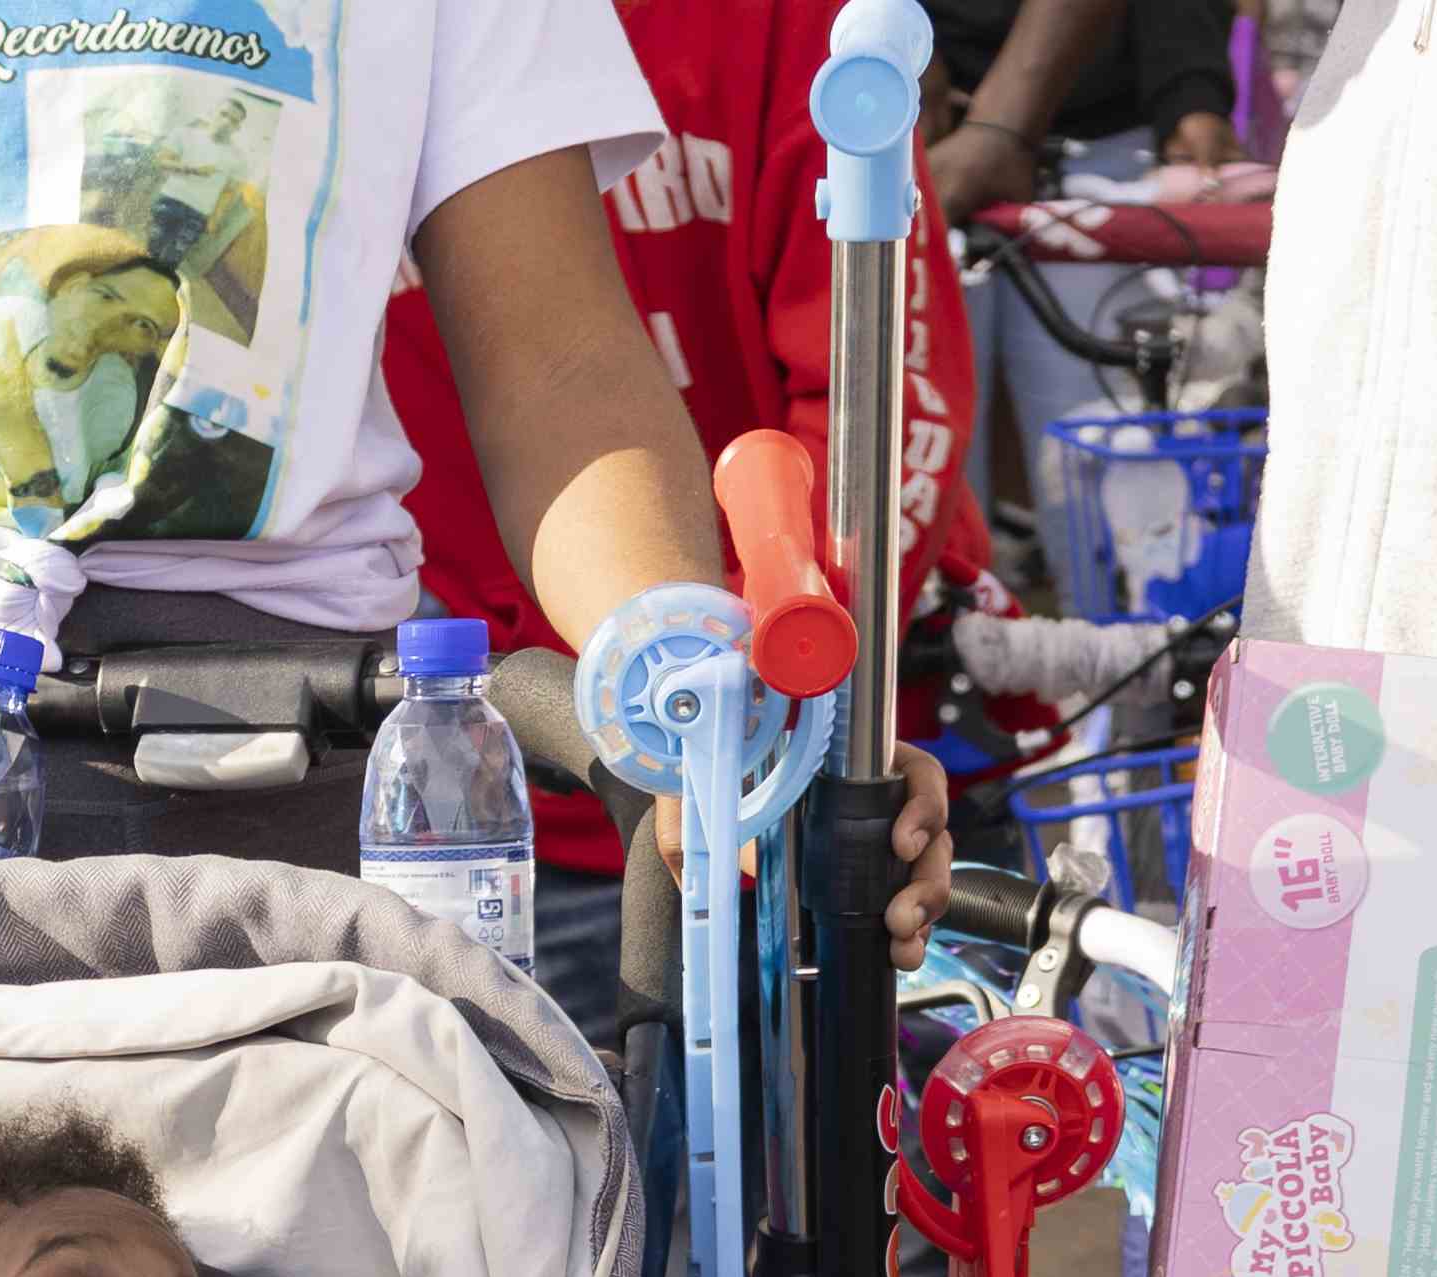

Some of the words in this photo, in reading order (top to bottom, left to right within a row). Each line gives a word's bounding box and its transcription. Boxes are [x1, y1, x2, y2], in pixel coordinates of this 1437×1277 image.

[1325, 702, 1340, 731] DOLL
[1308, 695, 1330, 782] INTERACTIVE
[1331, 735, 1345, 772] BABY
[1320, 831, 1332, 862] DOLL
[1326, 867, 1340, 902] BABY
[1305, 1124, 1333, 1204] Baby
[1249, 1230, 1283, 1274] My
